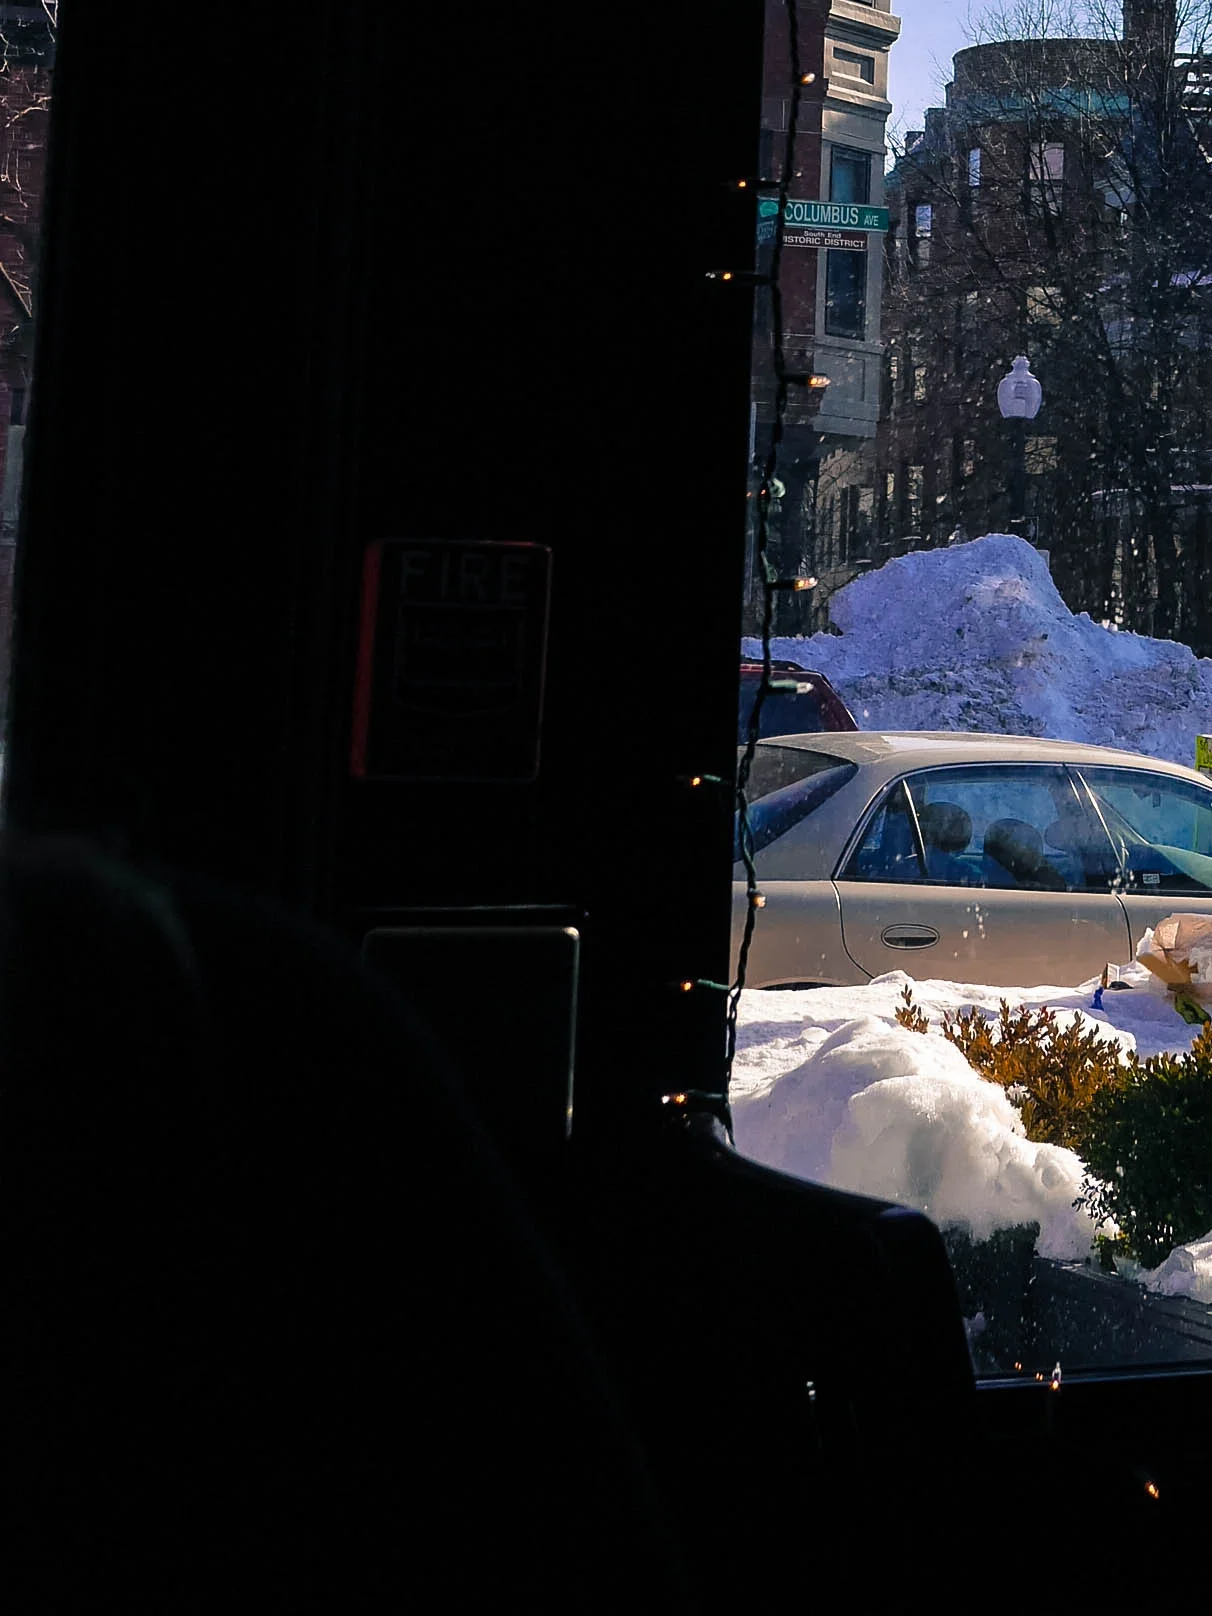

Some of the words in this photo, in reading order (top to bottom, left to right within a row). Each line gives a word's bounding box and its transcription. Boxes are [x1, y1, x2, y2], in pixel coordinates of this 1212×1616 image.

[784, 203, 859, 225] COLUMBUS
[863, 215, 879, 226] AVE
[803, 230, 825, 238] South
[824, 238, 865, 248] DISTRICT
[400, 550, 530, 600] FIRE
